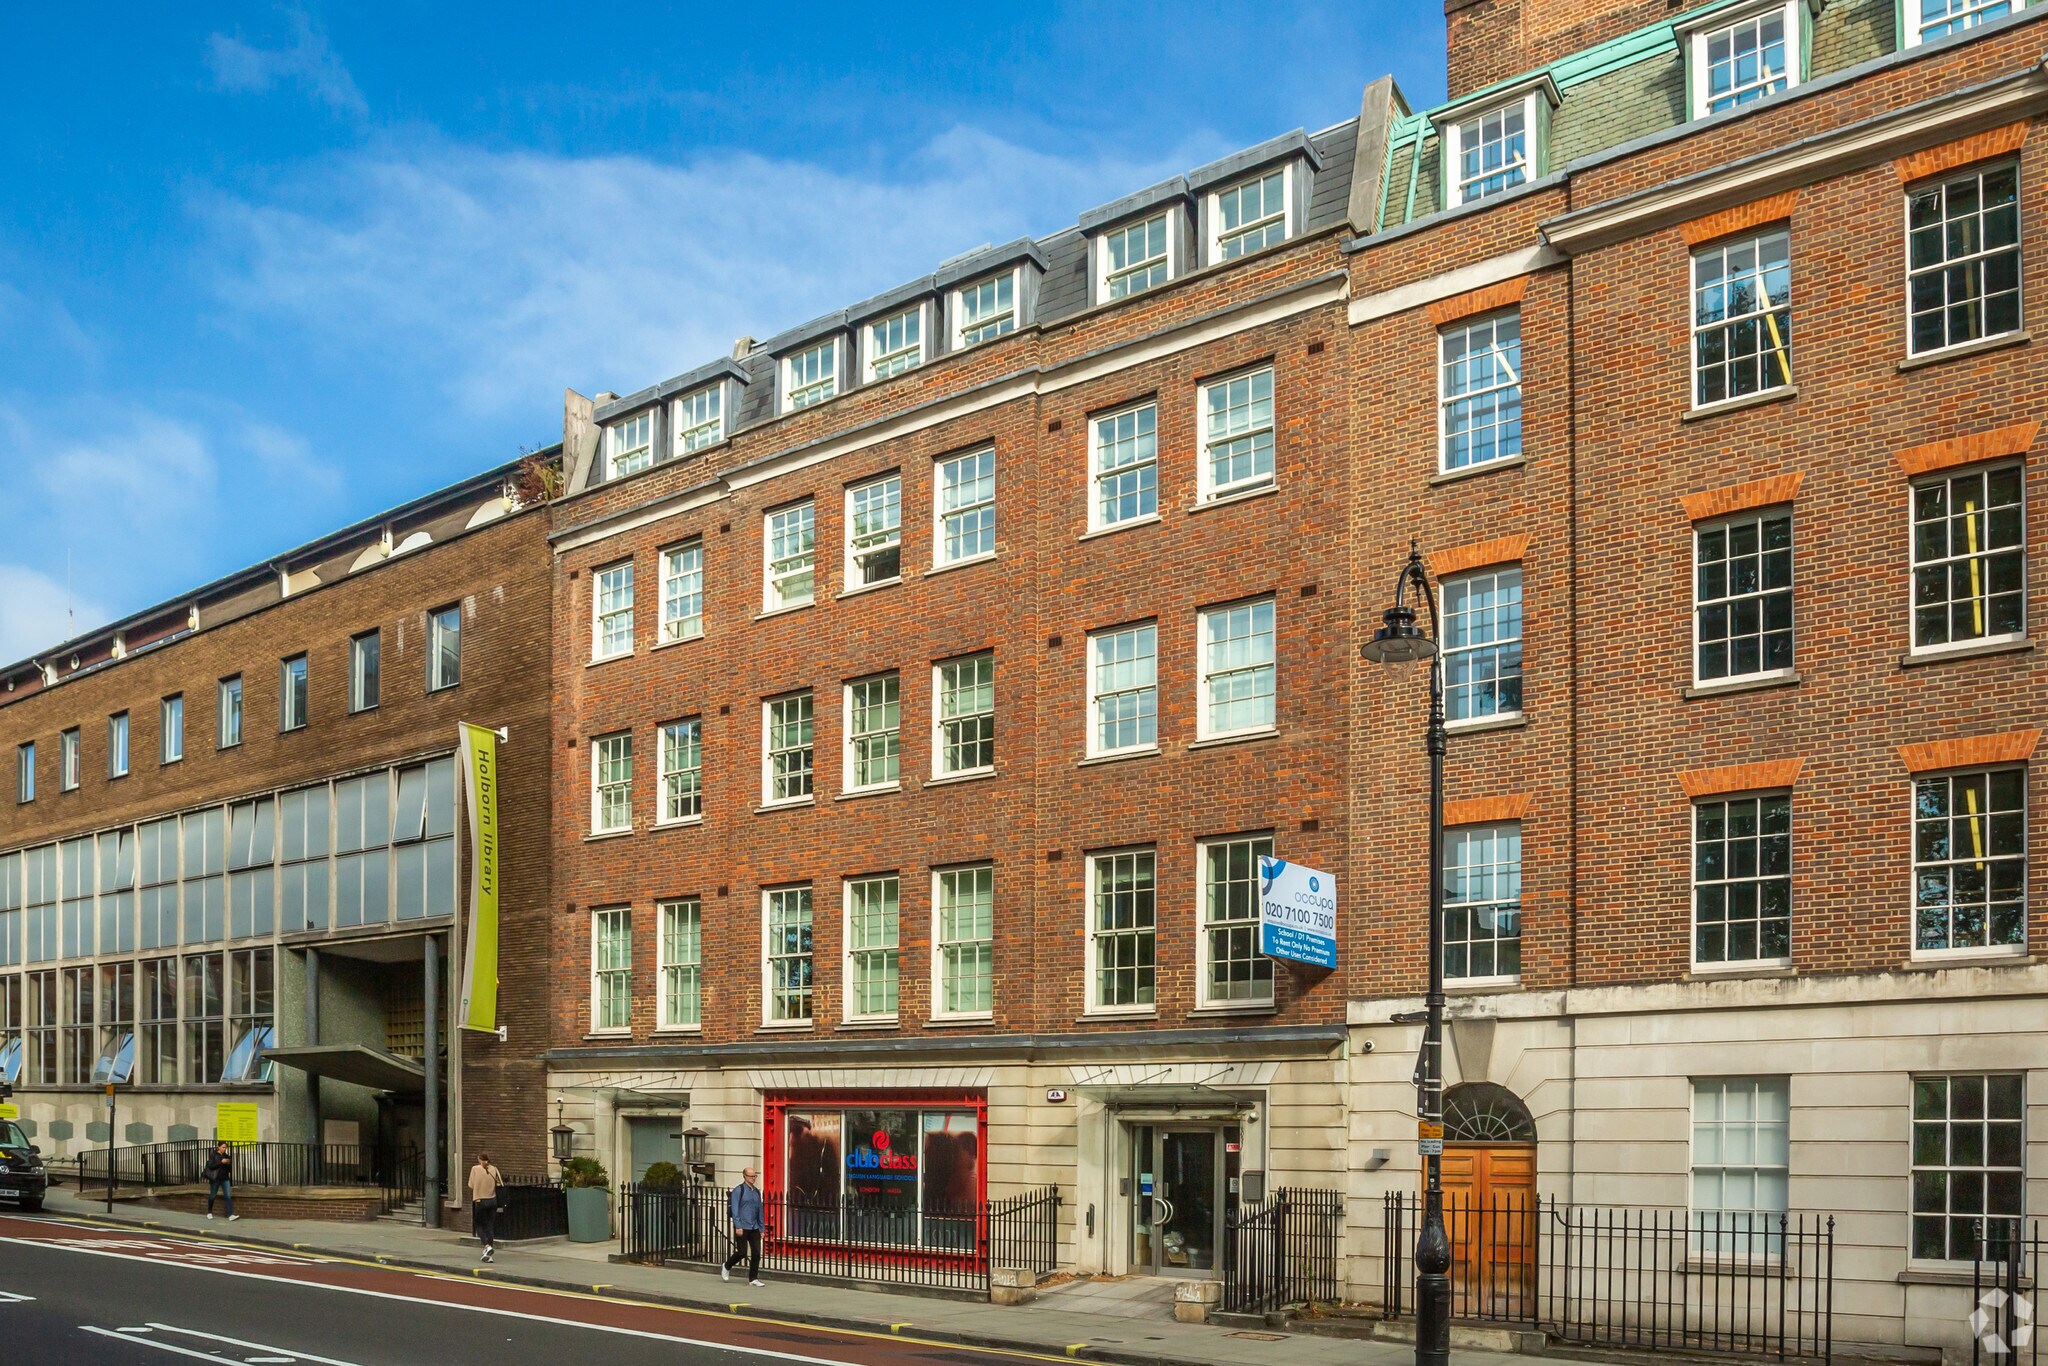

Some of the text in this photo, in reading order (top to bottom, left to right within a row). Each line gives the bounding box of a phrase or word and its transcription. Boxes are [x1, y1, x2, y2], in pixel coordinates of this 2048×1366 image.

[477, 749, 494, 896] Holborn library
[1295, 892, 1334, 911] occupa
[1265, 901, 1283, 919] 020
[1285, 906, 1310, 924] 7100
[1313, 912, 1334, 930] 7500
[1272, 936, 1331, 956] To Rent Only No Premium
[1278, 928, 1294, 938] School
[1306, 934, 1325, 946] Premises
[1275, 946, 1328, 964] Other Uses Considered
[846, 1148, 917, 1170] clubclass
